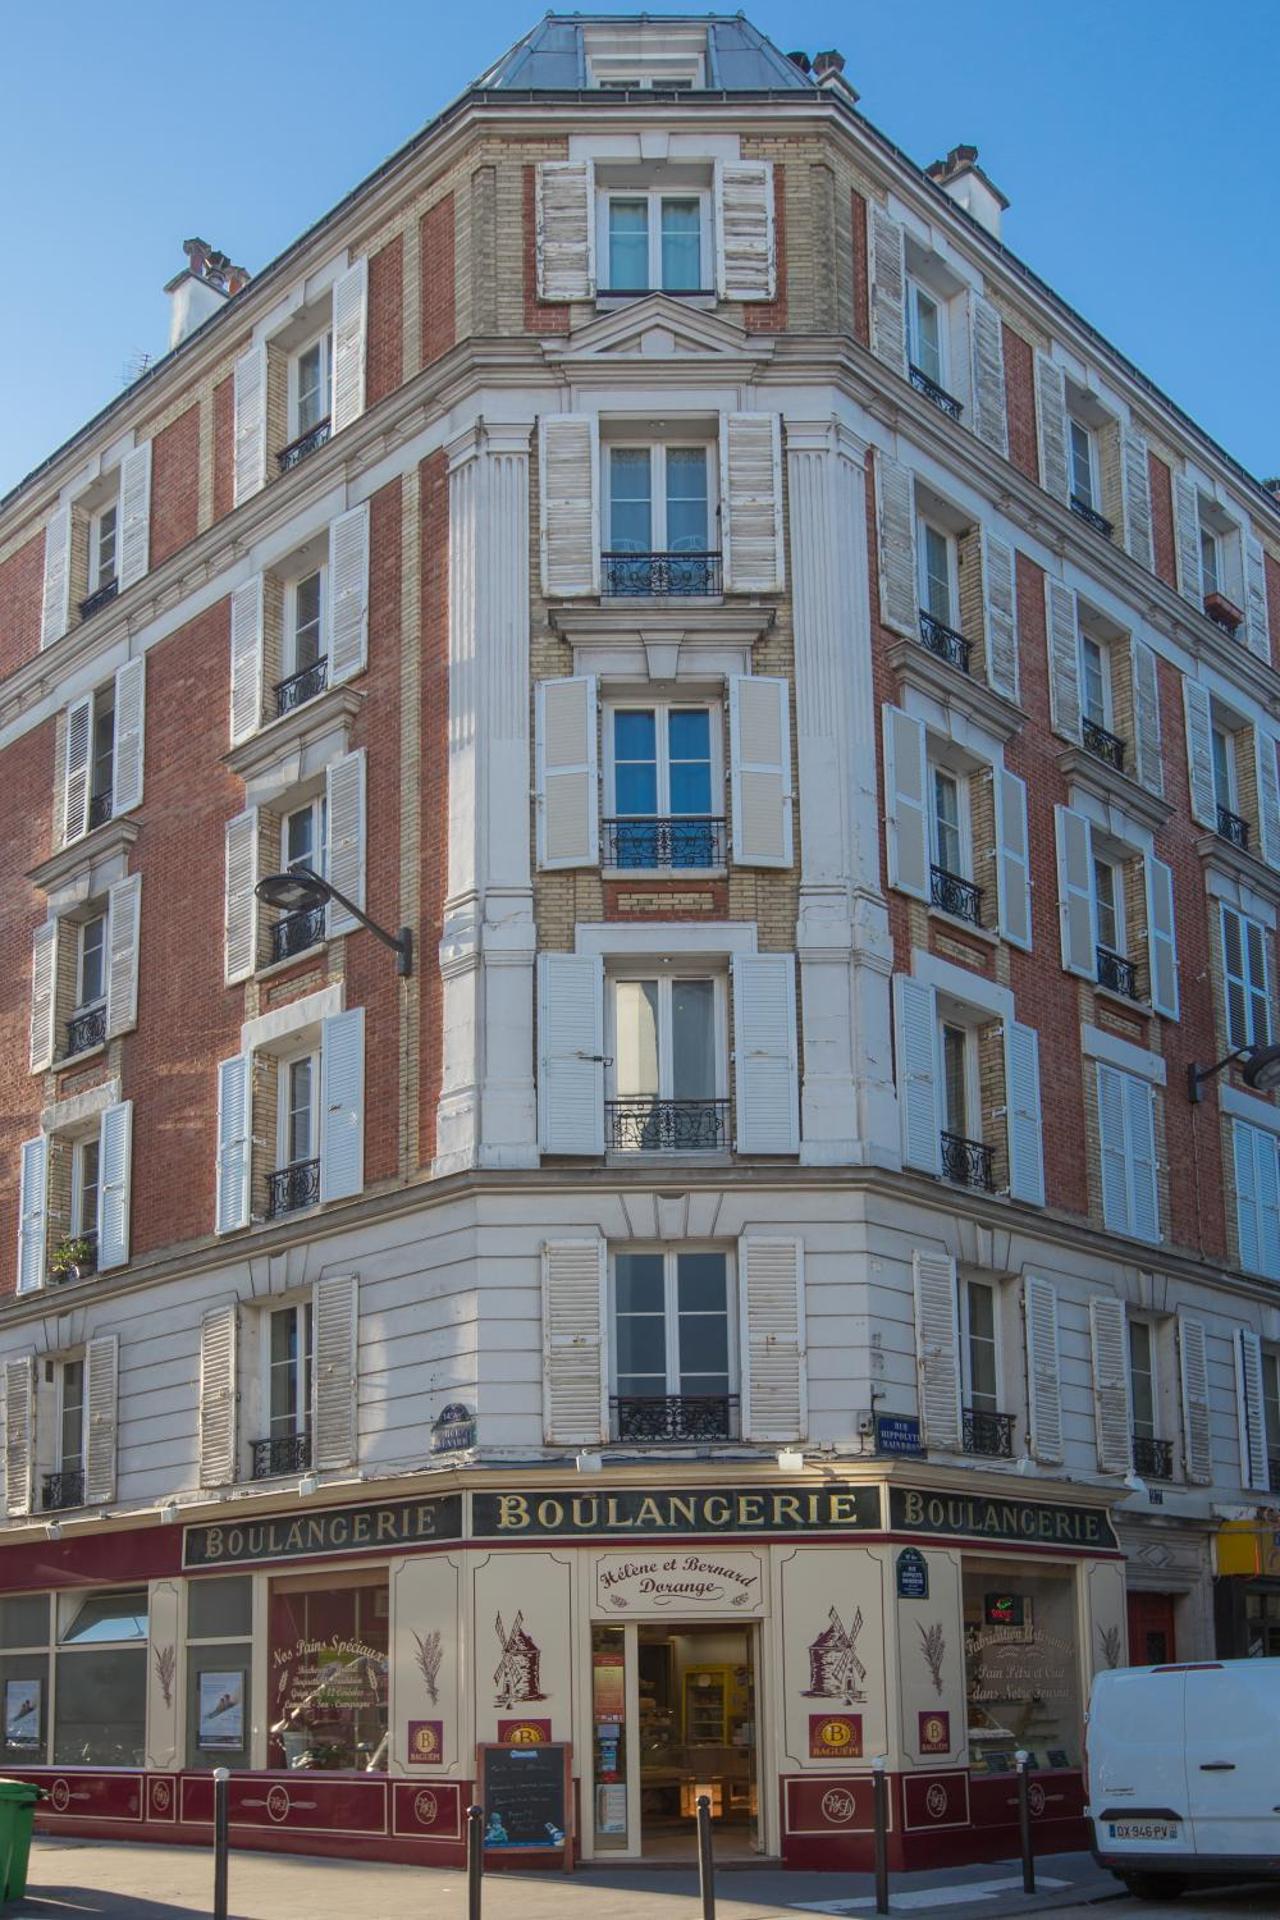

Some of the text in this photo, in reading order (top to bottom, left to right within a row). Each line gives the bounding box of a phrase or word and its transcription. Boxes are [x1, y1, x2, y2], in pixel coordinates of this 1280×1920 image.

[497, 1494, 857, 1530] BOULANGERIE
[903, 1490, 1099, 1541] BOULANGERIE
[204, 1505, 436, 1559] BOULANGERIE
[600, 1556, 758, 1590] Hélène et Bernard
[639, 1577, 721, 1597] Dorange
[272, 1647, 293, 1669] Nos
[296, 1638, 327, 1657] Pains
[331, 1634, 385, 1662] Spéciaux
[972, 1685, 1001, 1700] dans
[420, 1732, 430, 1748] B
[830, 1725, 844, 1742] B
